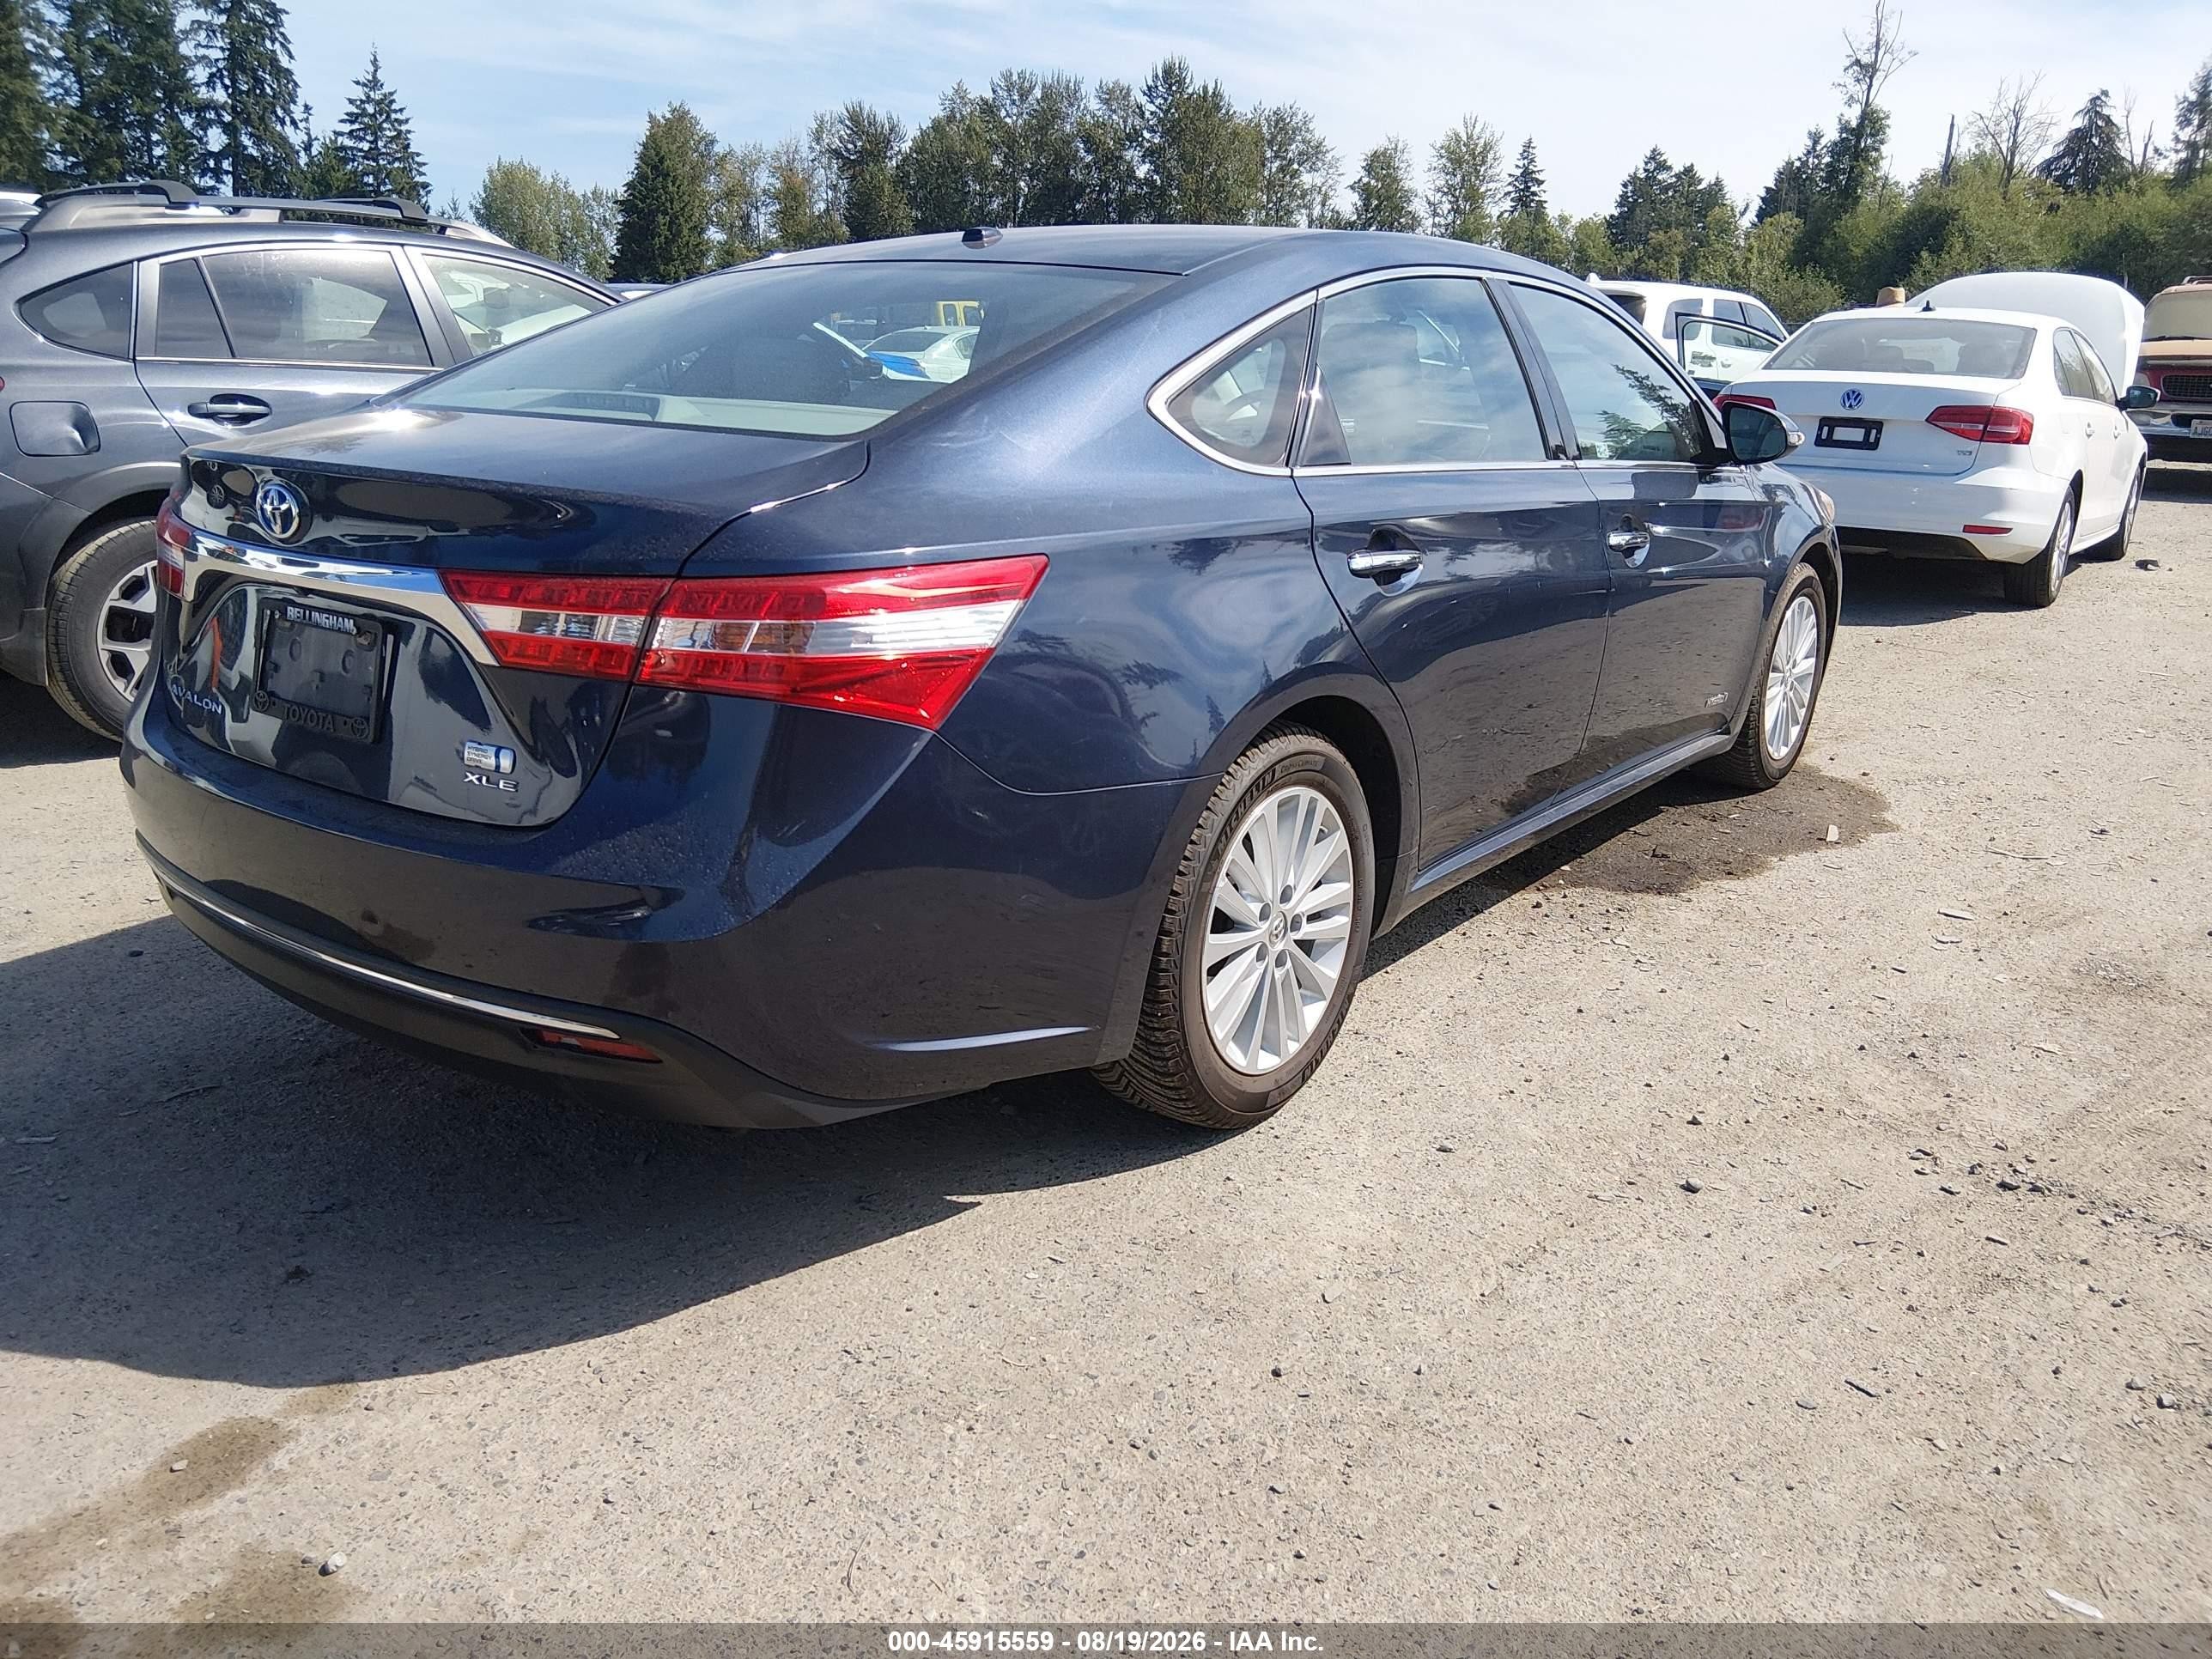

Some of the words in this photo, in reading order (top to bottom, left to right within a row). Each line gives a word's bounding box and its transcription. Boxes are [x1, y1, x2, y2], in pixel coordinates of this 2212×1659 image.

[287, 605, 355, 634] BELLINGHAM
[172, 684, 222, 714] AVALON
[283, 704, 335, 732] TOYOTA
[464, 772, 518, 792] XLE
[1216, 766, 1277, 854] MICHELIN
